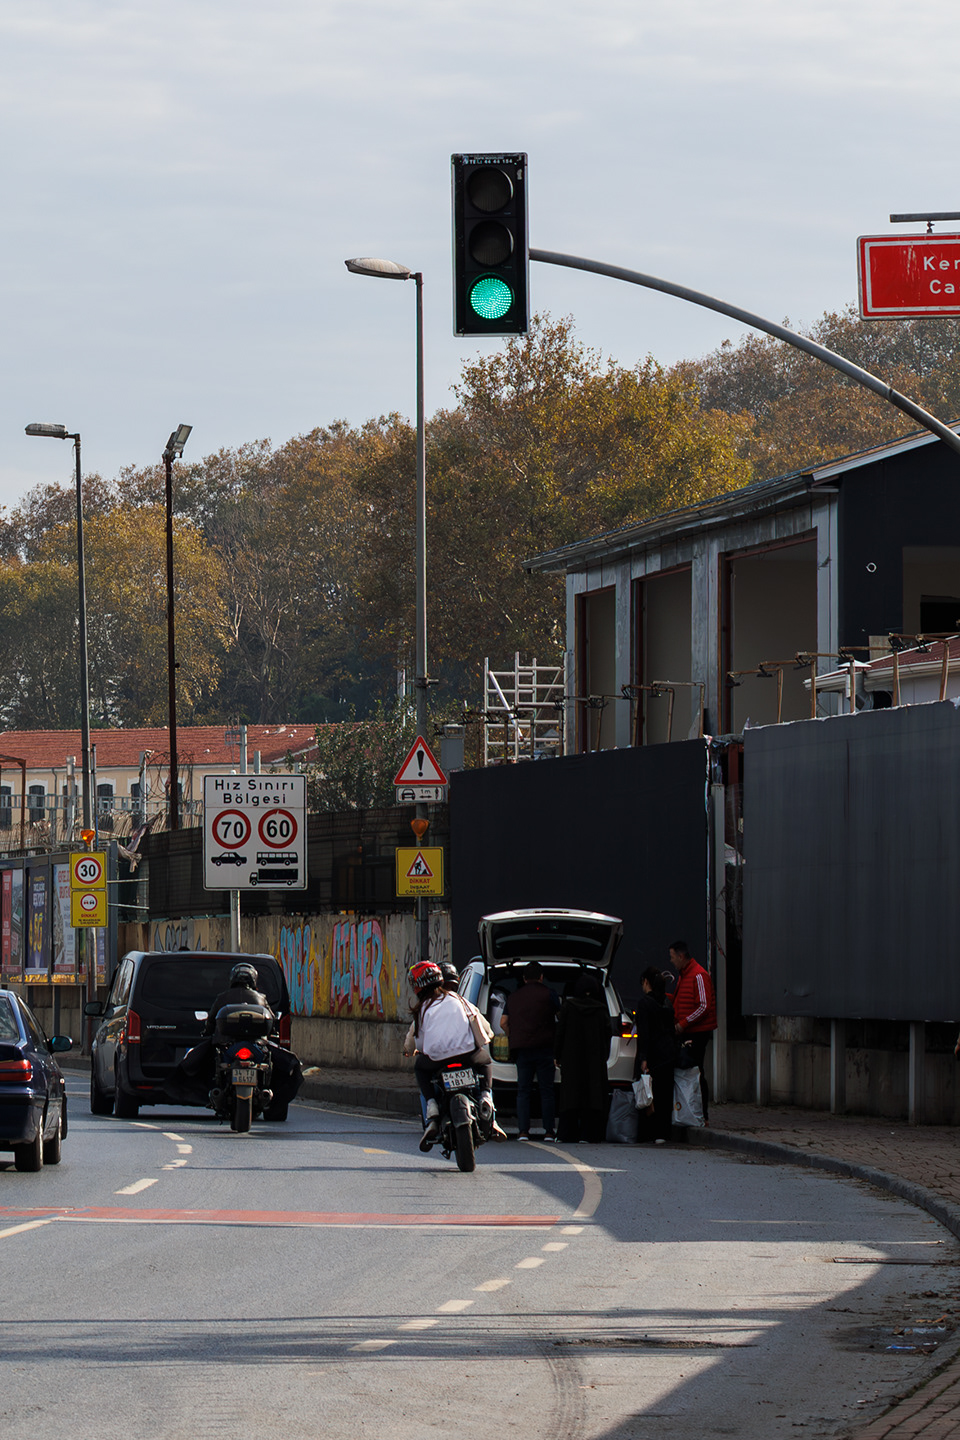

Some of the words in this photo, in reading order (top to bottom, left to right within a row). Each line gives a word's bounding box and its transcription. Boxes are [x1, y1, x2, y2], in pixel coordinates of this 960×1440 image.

[215, 779, 241, 790] Hız
[247, 779, 294, 790] Sınırı
[223, 792, 286, 807] Bölgesi
[221, 821, 244, 838] 70
[266, 820, 290, 838] 60
[80, 864, 96, 877] 30
[443, 1073, 454, 1081] 34
